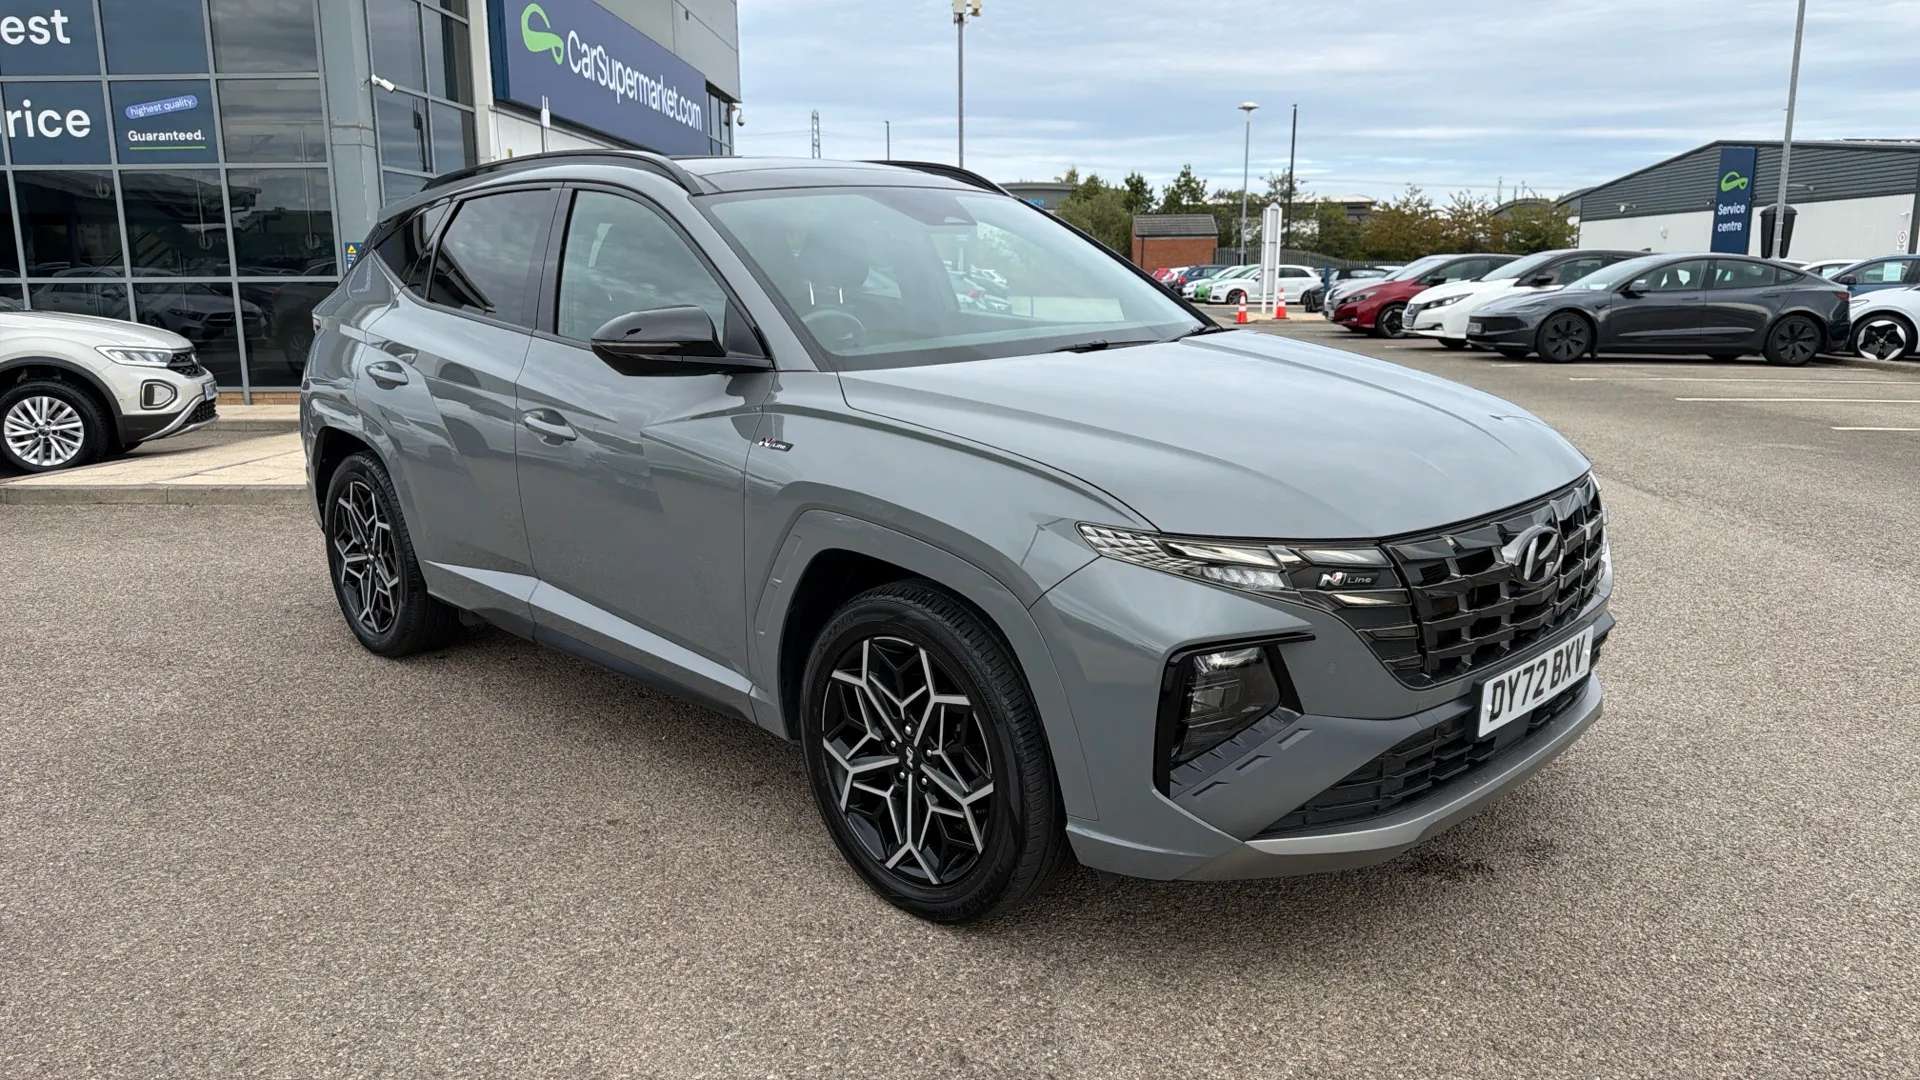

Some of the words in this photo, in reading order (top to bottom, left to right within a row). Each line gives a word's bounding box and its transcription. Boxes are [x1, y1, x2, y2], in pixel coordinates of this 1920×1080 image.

[0, 9, 71, 45] est
[567, 29, 703, 132] CarSupermarket.com
[0, 98, 91, 138] rice
[130, 103, 162, 117] highest
[127, 129, 206, 142] Guaranteed.
[1717, 202, 1746, 216] Service
[1717, 220, 1743, 232] centre
[1489, 658, 1548, 723] DY72
[1549, 634, 1587, 690] BXV
